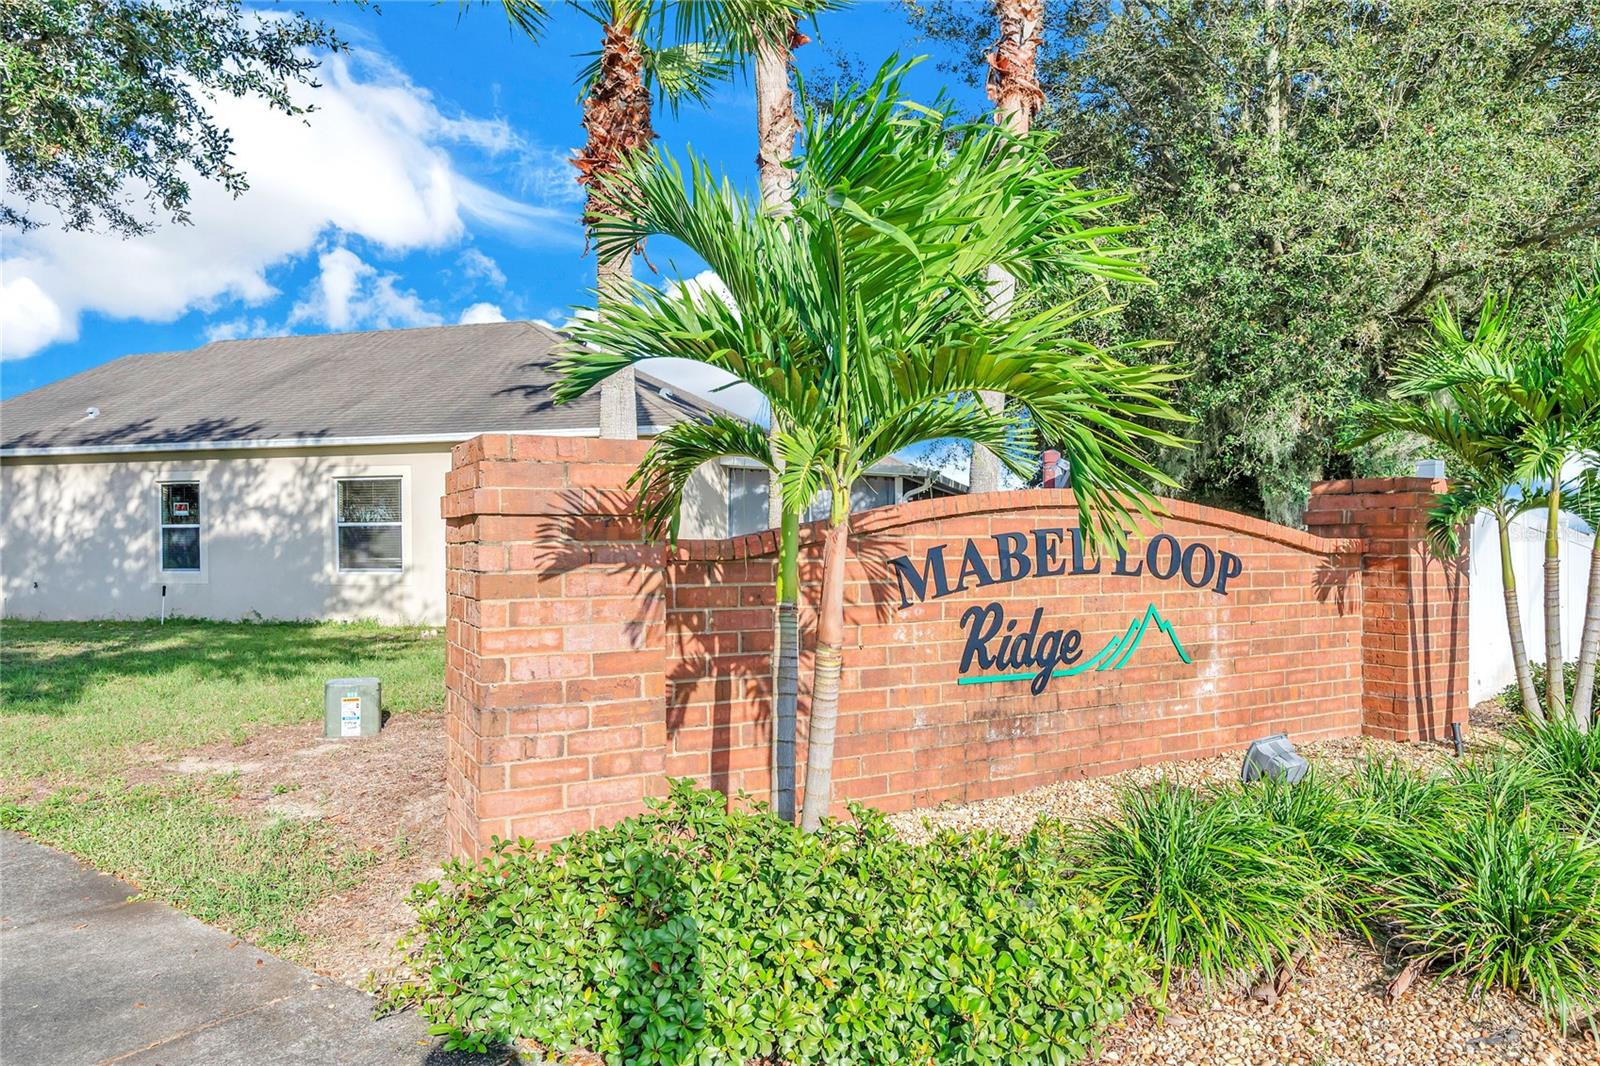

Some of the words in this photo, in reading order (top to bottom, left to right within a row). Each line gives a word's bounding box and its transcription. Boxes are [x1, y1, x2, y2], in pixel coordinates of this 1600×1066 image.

[887, 528, 1101, 611] MABEL
[1111, 529, 1243, 596] LOOP
[959, 601, 1084, 697] Ridge
